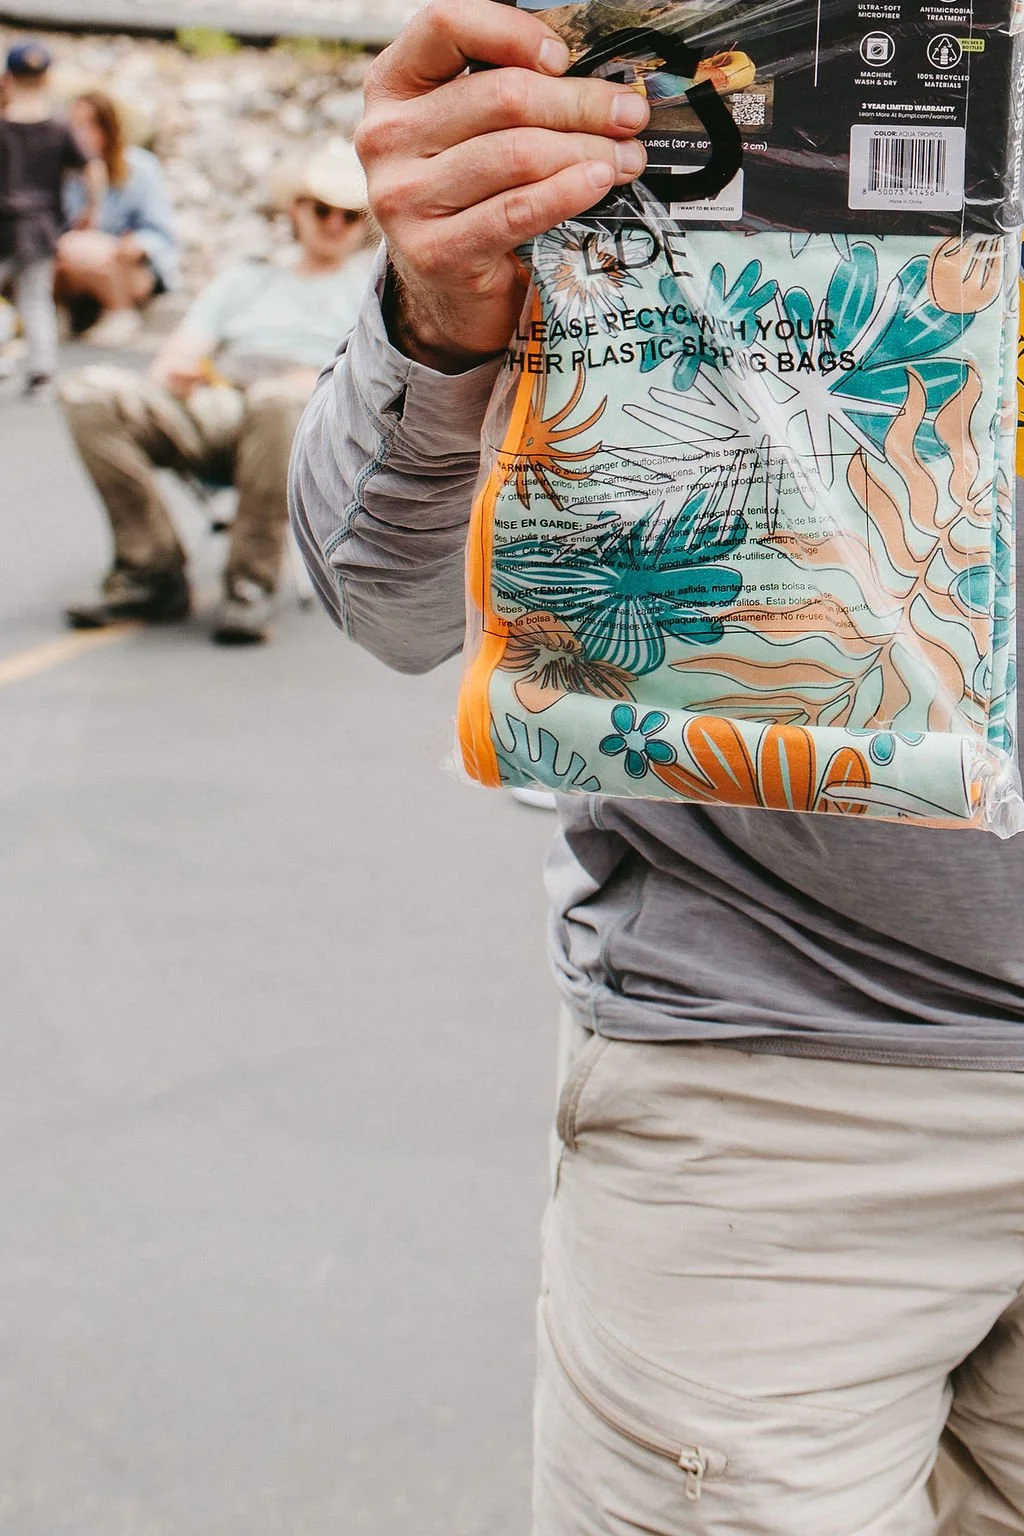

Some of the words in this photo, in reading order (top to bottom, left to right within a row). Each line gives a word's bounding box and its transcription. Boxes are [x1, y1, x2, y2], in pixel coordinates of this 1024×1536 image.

[858, 11, 901, 19] MICROFIBER
[920, 6, 974, 15] ANTIMICROBIAL
[926, 14, 967, 22] TREATMENT
[924, 81, 962, 89] MATERIALS
[886, 103, 914, 111] LIMITED
[914, 104, 955, 112] WARRANTY
[898, 130, 916, 138] AQUA
[644, 139, 670, 149] LARGE
[750, 141, 768, 152] cm)
[755, 319, 836, 341] YOUR
[571, 337, 674, 372] PLASTIC
[778, 350, 864, 372] BAGS.
[551, 464, 561, 474] To
[563, 463, 587, 474] avoid
[589, 461, 618, 474] danger
[621, 458, 631, 468] of
[682, 451, 707, 462] keep
[723, 447, 741, 459] bag
[552, 477, 575, 490] cribs,
[577, 478, 600, 490] beds,
[720, 462, 738, 474] bag
[572, 491, 611, 503] materials
[665, 484, 684, 494] after
[687, 479, 728, 491] removing
[494, 518, 518, 529] MISE
[521, 518, 537, 528] EN
[540, 519, 583, 531] GARDE:
[733, 550, 778, 561] ré-utiliser
[678, 583, 709, 596] asfixia,
[712, 582, 758, 594] mantenga
[760, 582, 780, 592] esta
[782, 581, 806, 591] bolsa
[766, 596, 786, 606] Esta
[788, 595, 812, 606] bolsa
[526, 614, 550, 625] bolsa
[781, 612, 793, 621] No
